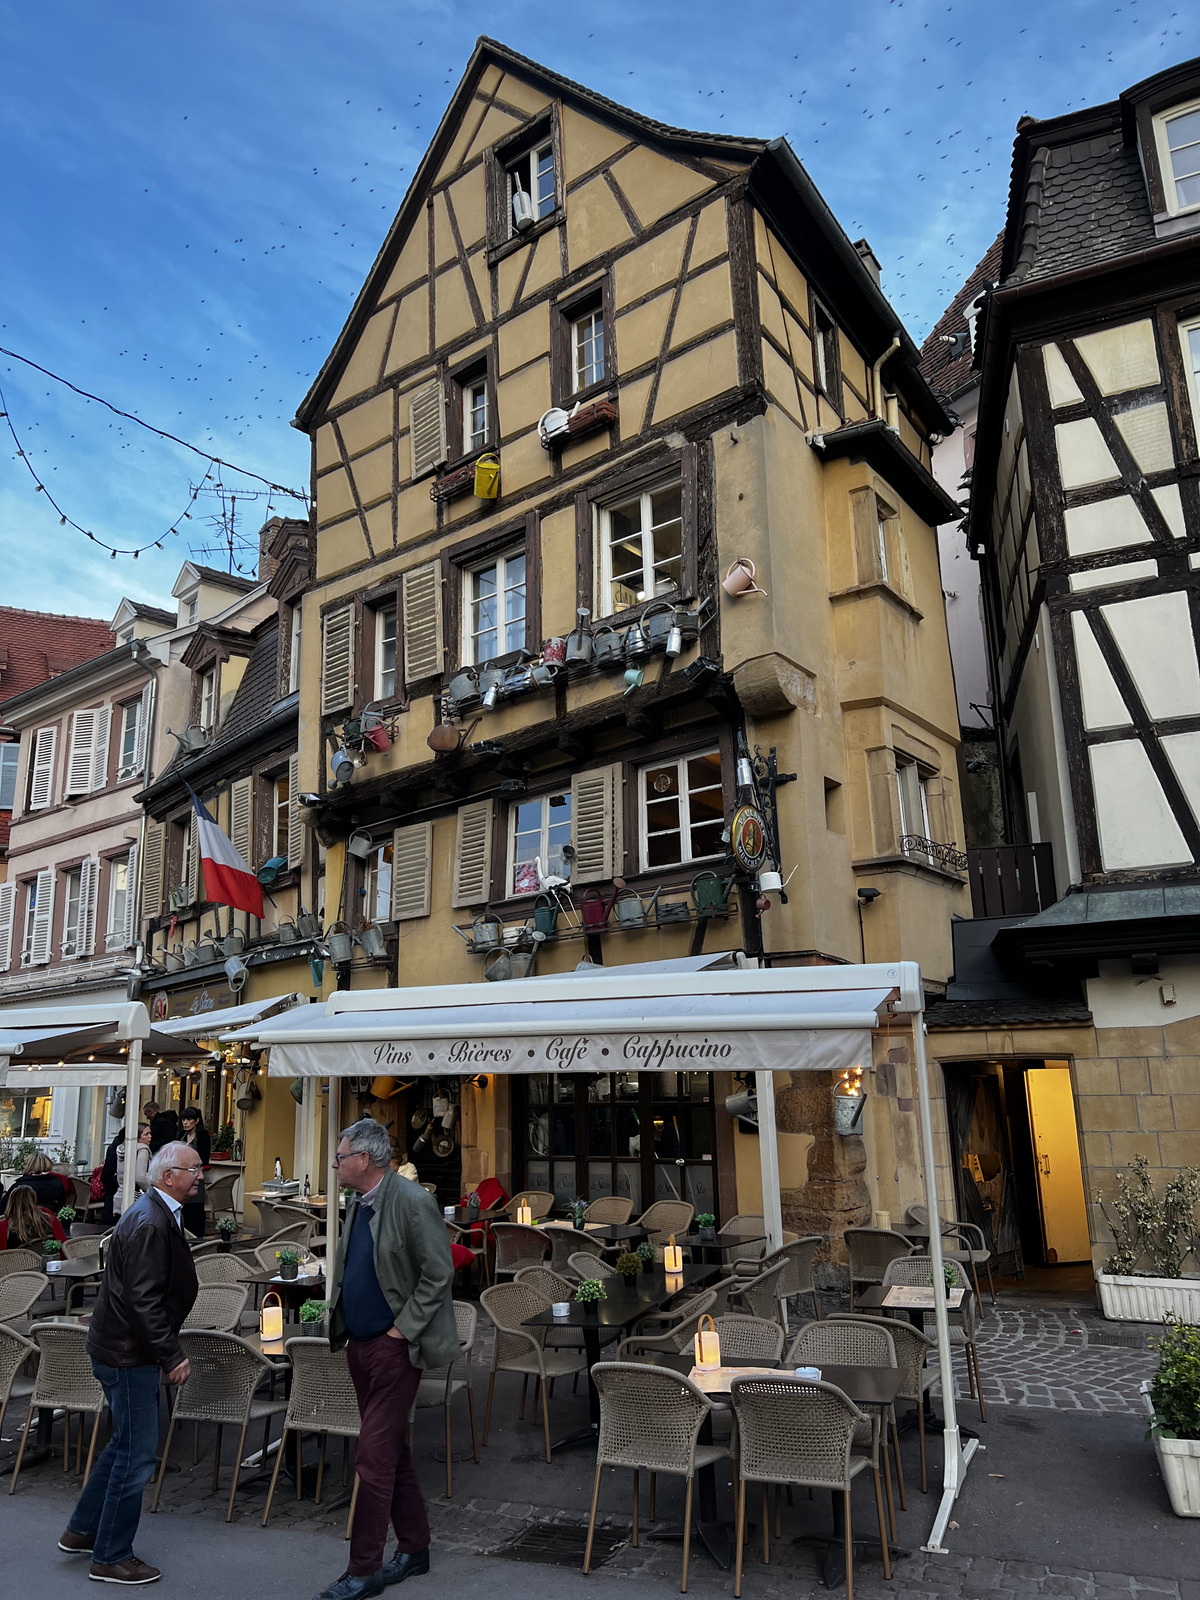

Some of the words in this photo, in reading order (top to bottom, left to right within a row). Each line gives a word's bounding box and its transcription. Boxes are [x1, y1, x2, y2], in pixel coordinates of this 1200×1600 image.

[373, 1042, 413, 1065] Vins
[448, 1039, 513, 1063] Bières
[545, 1036, 590, 1069] Café
[622, 1034, 734, 1068] Cappucino
